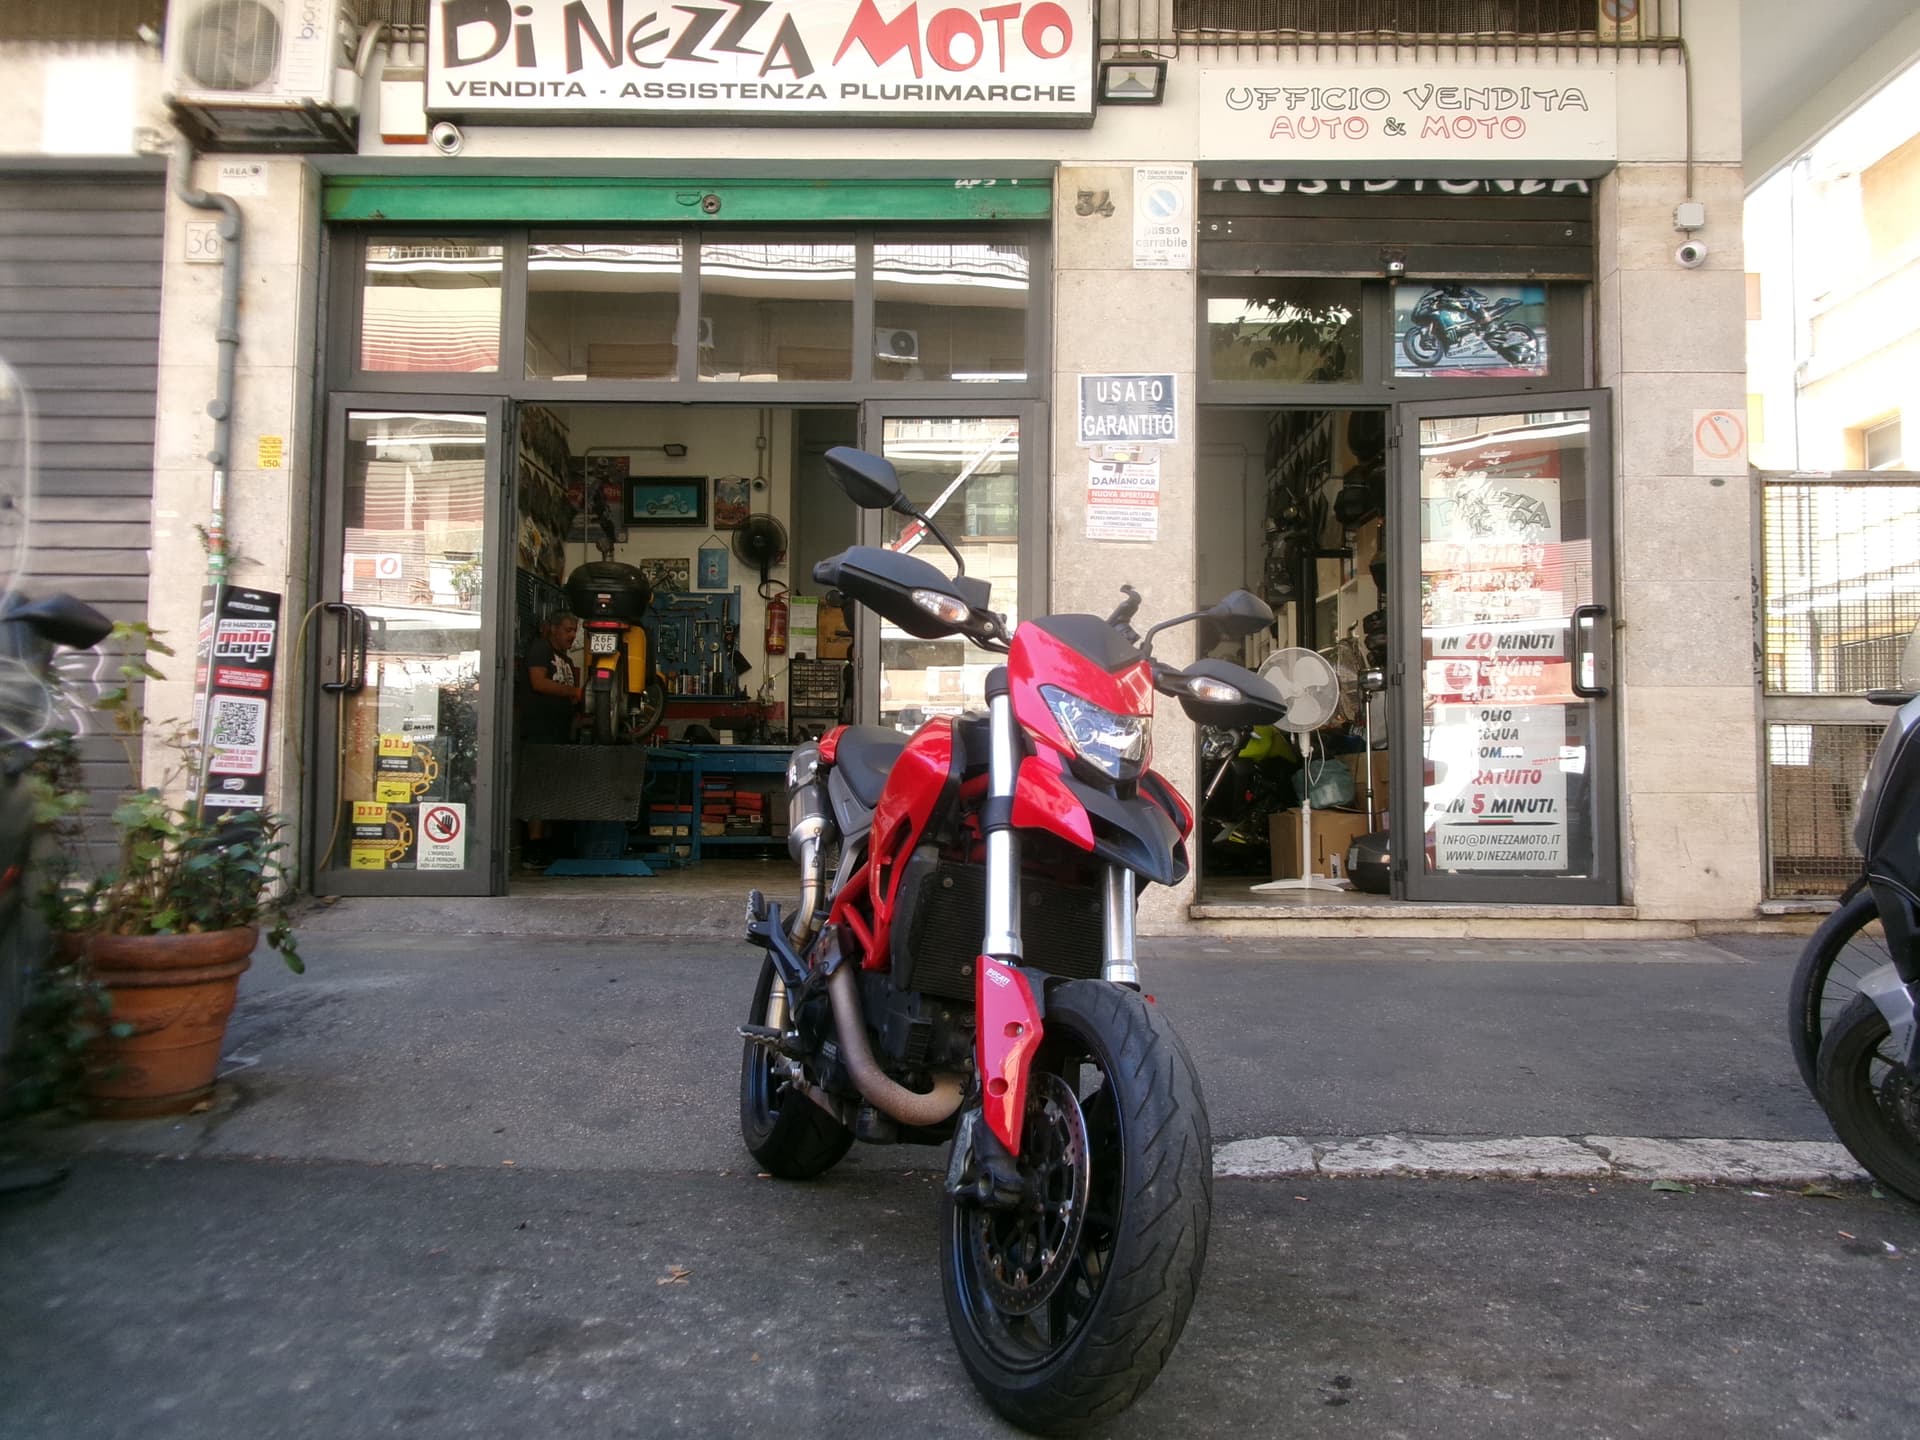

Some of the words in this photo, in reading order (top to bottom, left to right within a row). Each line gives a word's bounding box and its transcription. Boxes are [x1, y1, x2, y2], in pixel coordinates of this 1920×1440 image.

[832, 0, 1073, 79] MOTO
[446, 81, 587, 98] VENDITA
[619, 82, 828, 100] ASSISTENZA
[840, 83, 1076, 102] PLURIMARCHE
[1225, 87, 1391, 111] UFFICIO
[1402, 83, 1590, 112] VENDITA
[1269, 116, 1370, 140] AUTO
[1383, 117, 1407, 137] &
[1420, 115, 1527, 140] MOTO
[223, 167, 248, 176] AREA
[1074, 187, 1116, 218] 34
[188, 228, 218, 254] 36
[1135, 236, 1188, 248] carrabile
[1097, 380, 1164, 403] USATO
[1083, 413, 1174, 437] GARANTITO
[1091, 476, 1139, 486] DAMIANO
[1139, 478, 1156, 486] CAR
[217, 641, 270, 661] days
[1440, 636, 1459, 650] IN
[1465, 632, 1493, 650] 20
[1497, 634, 1555, 650] MINUTI
[1480, 710, 1513, 722] OLIO
[357, 805, 384, 817] DID
[1471, 793, 1486, 815] 5
[1490, 798, 1558, 814] MINUTI.
[1442, 834, 1561, 847] INFO@DINEZZAMOTO.IT
[1446, 850, 1559, 862] WWW.DINEZZAMOTO.IT
